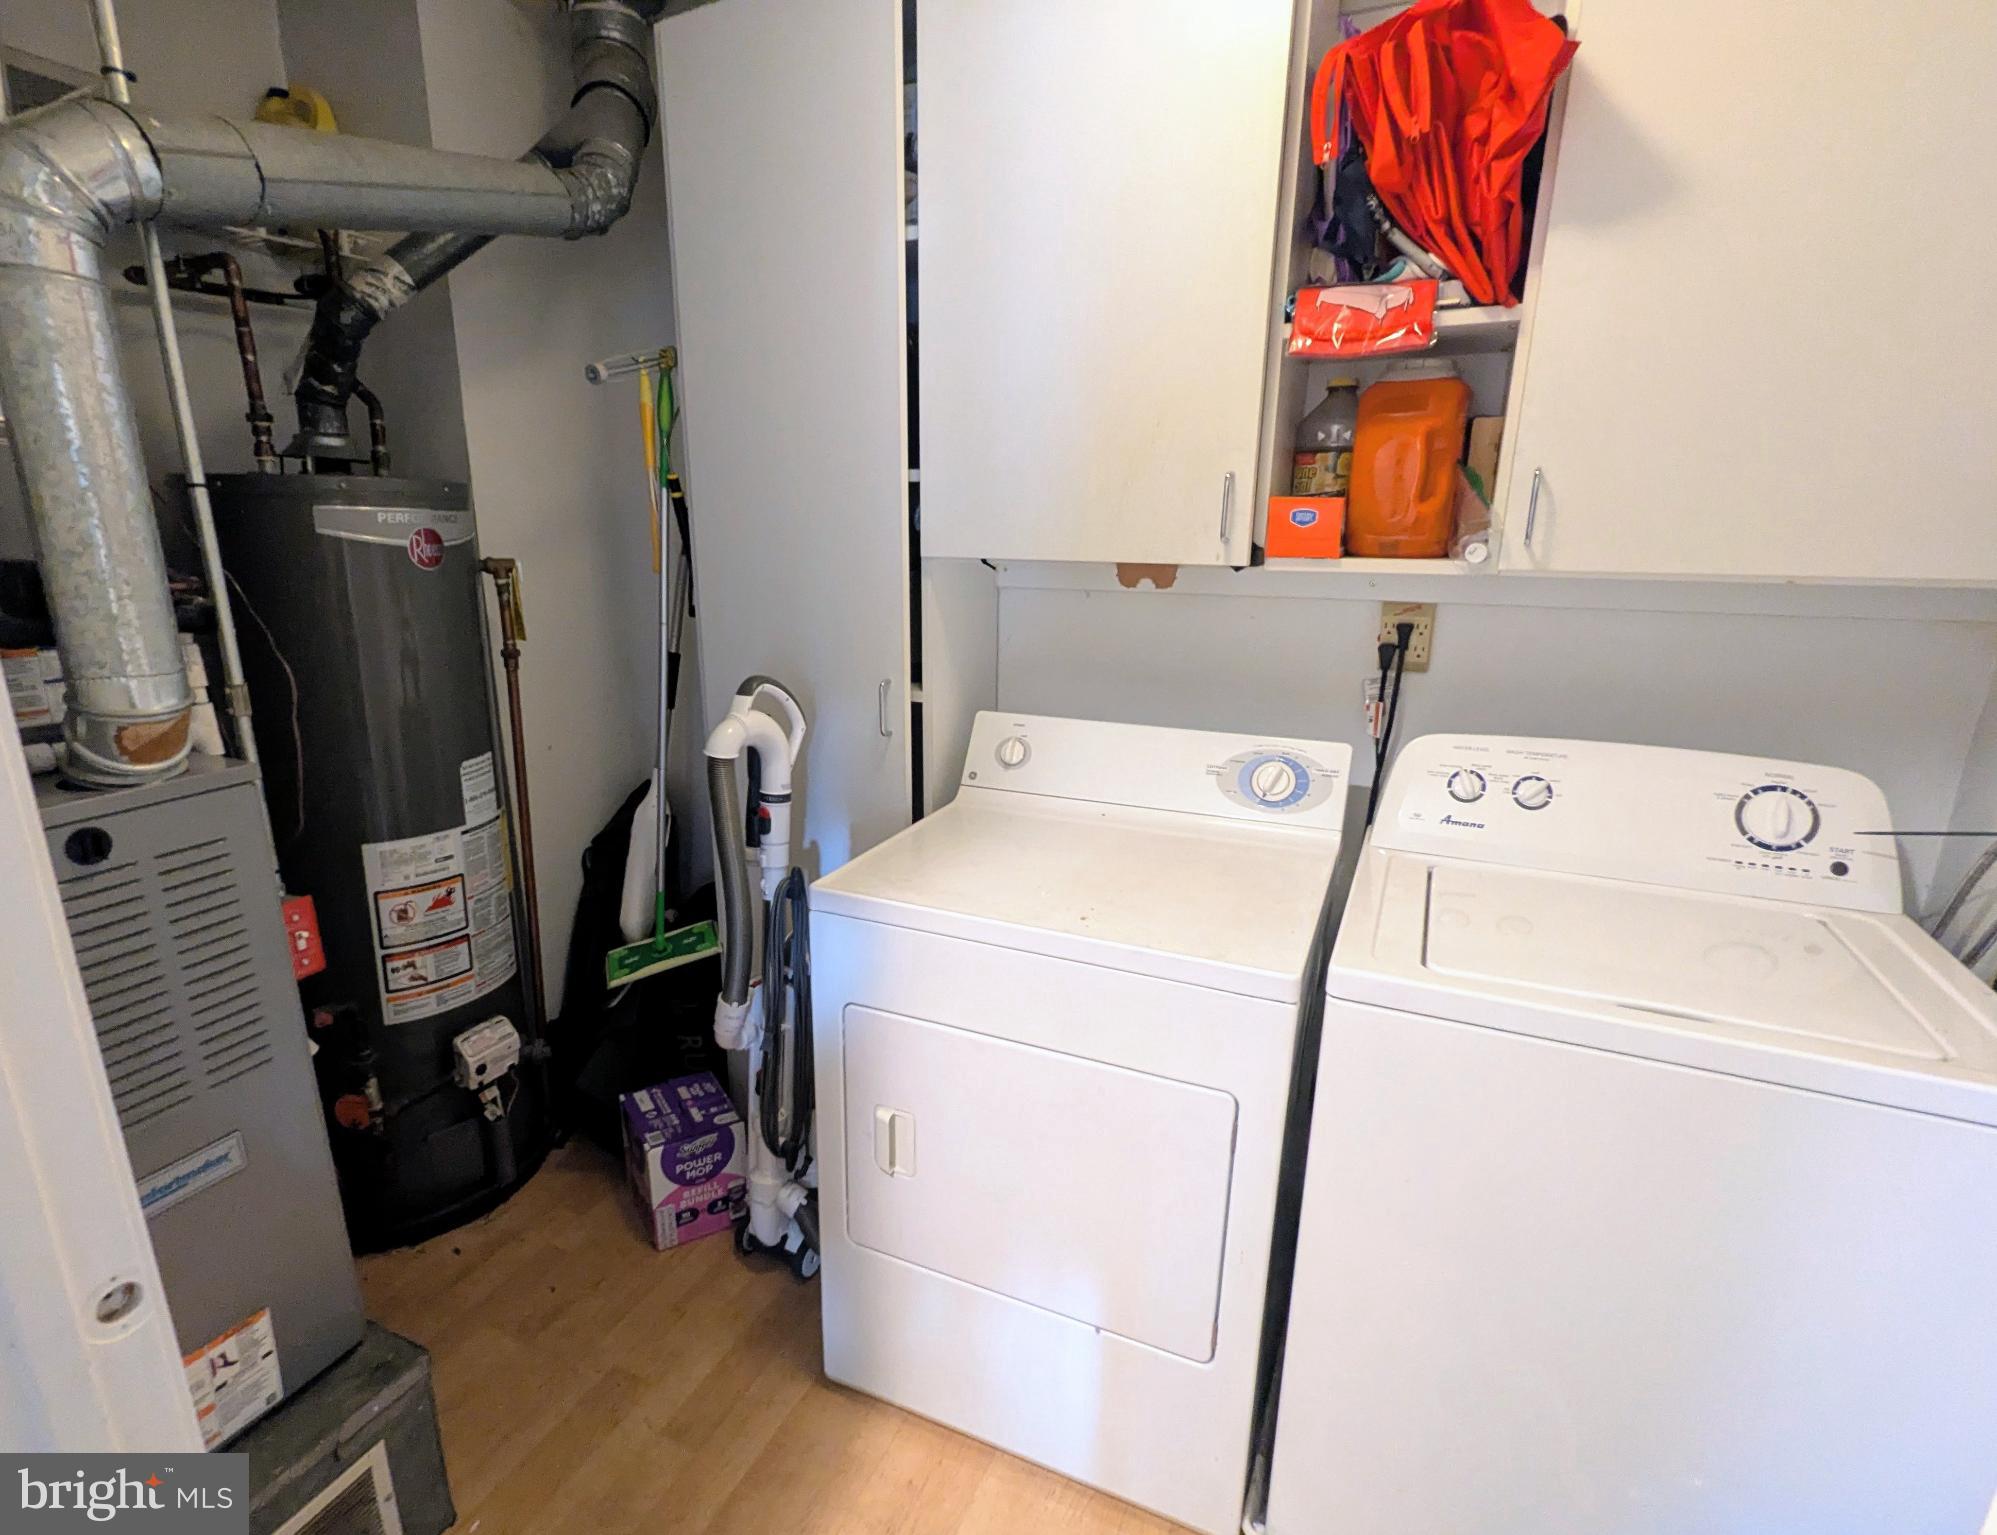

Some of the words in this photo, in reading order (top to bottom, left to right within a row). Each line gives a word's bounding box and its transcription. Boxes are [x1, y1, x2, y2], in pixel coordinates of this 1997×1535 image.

[1440, 814, 1486, 829] Amana
[675, 1152, 722, 1175] POWER
[686, 1164, 714, 1180] MOP
